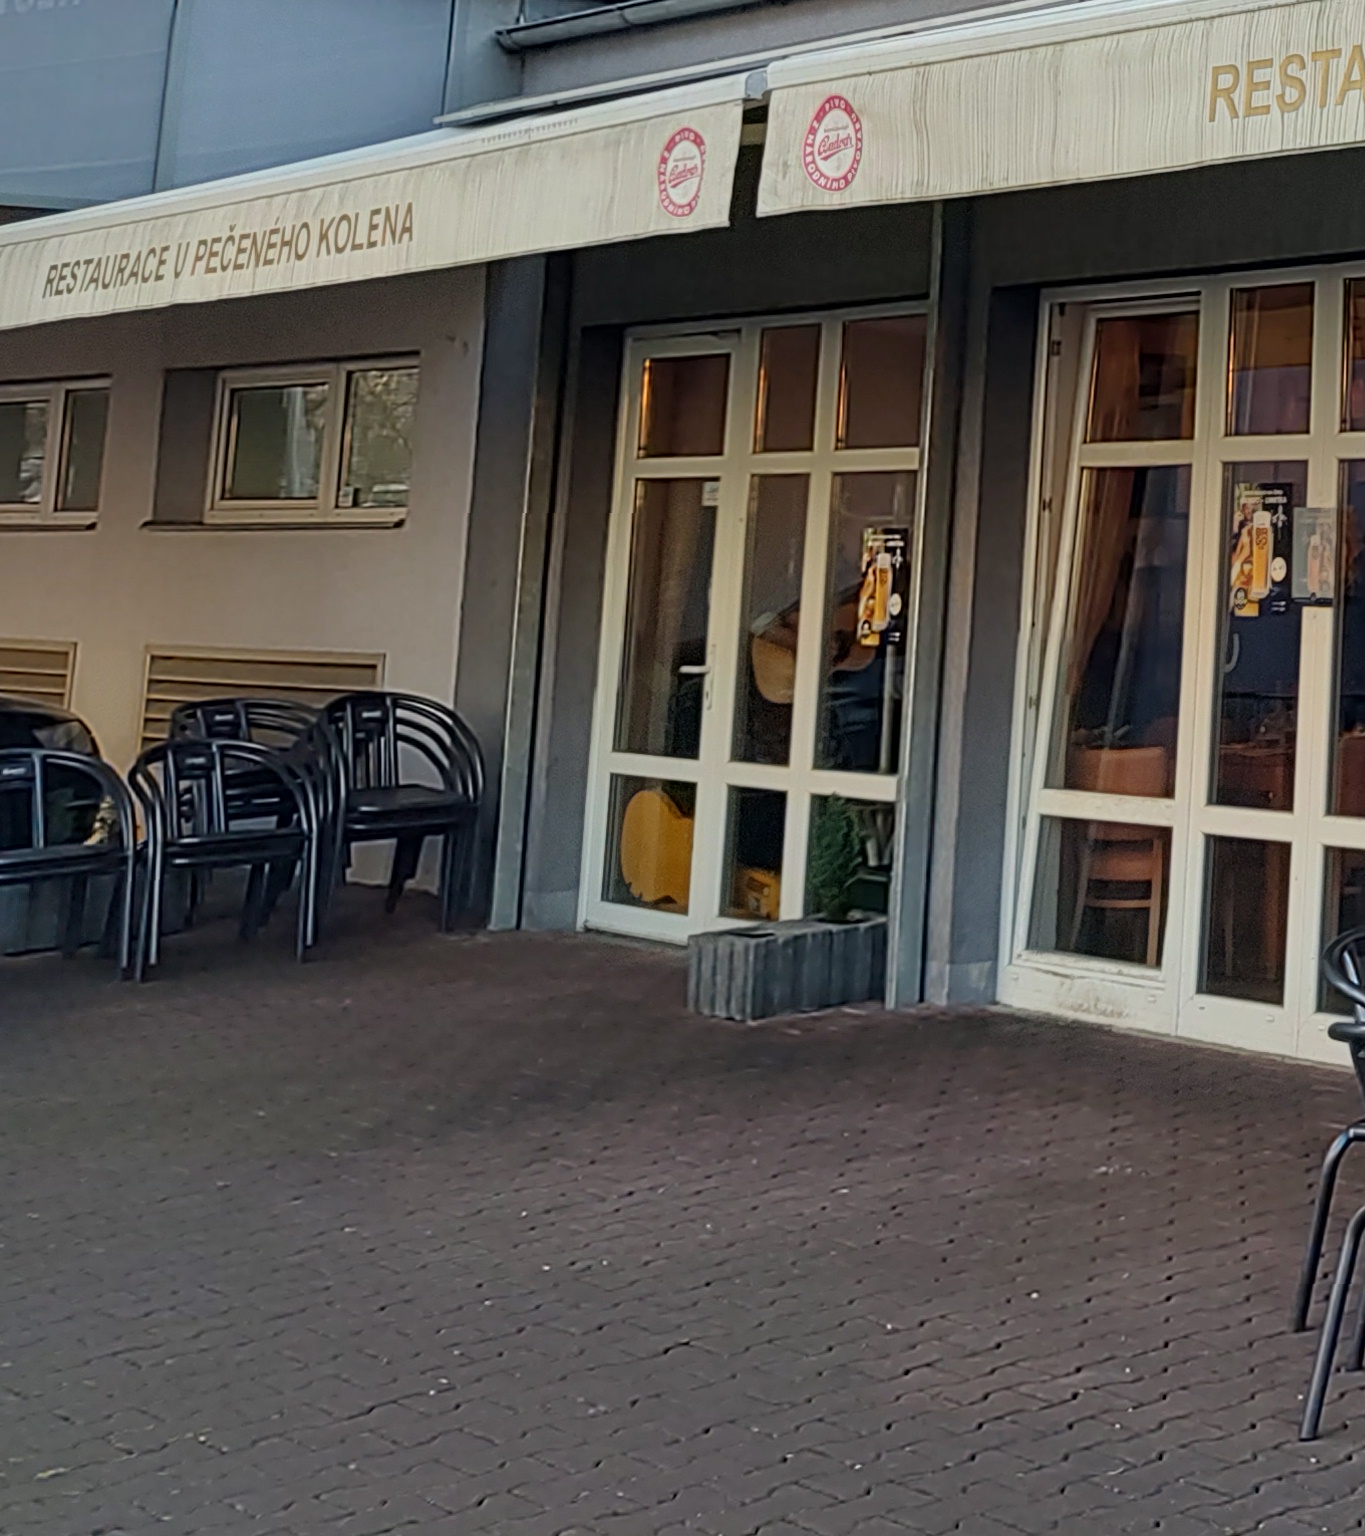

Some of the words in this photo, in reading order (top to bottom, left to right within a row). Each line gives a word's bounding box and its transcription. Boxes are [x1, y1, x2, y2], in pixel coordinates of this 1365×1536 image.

[42, 244, 169, 299] RESTAURACE
[173, 244, 188, 280] U
[191, 218, 312, 278] PEČENÉHO
[318, 201, 414, 260] KOLENA
